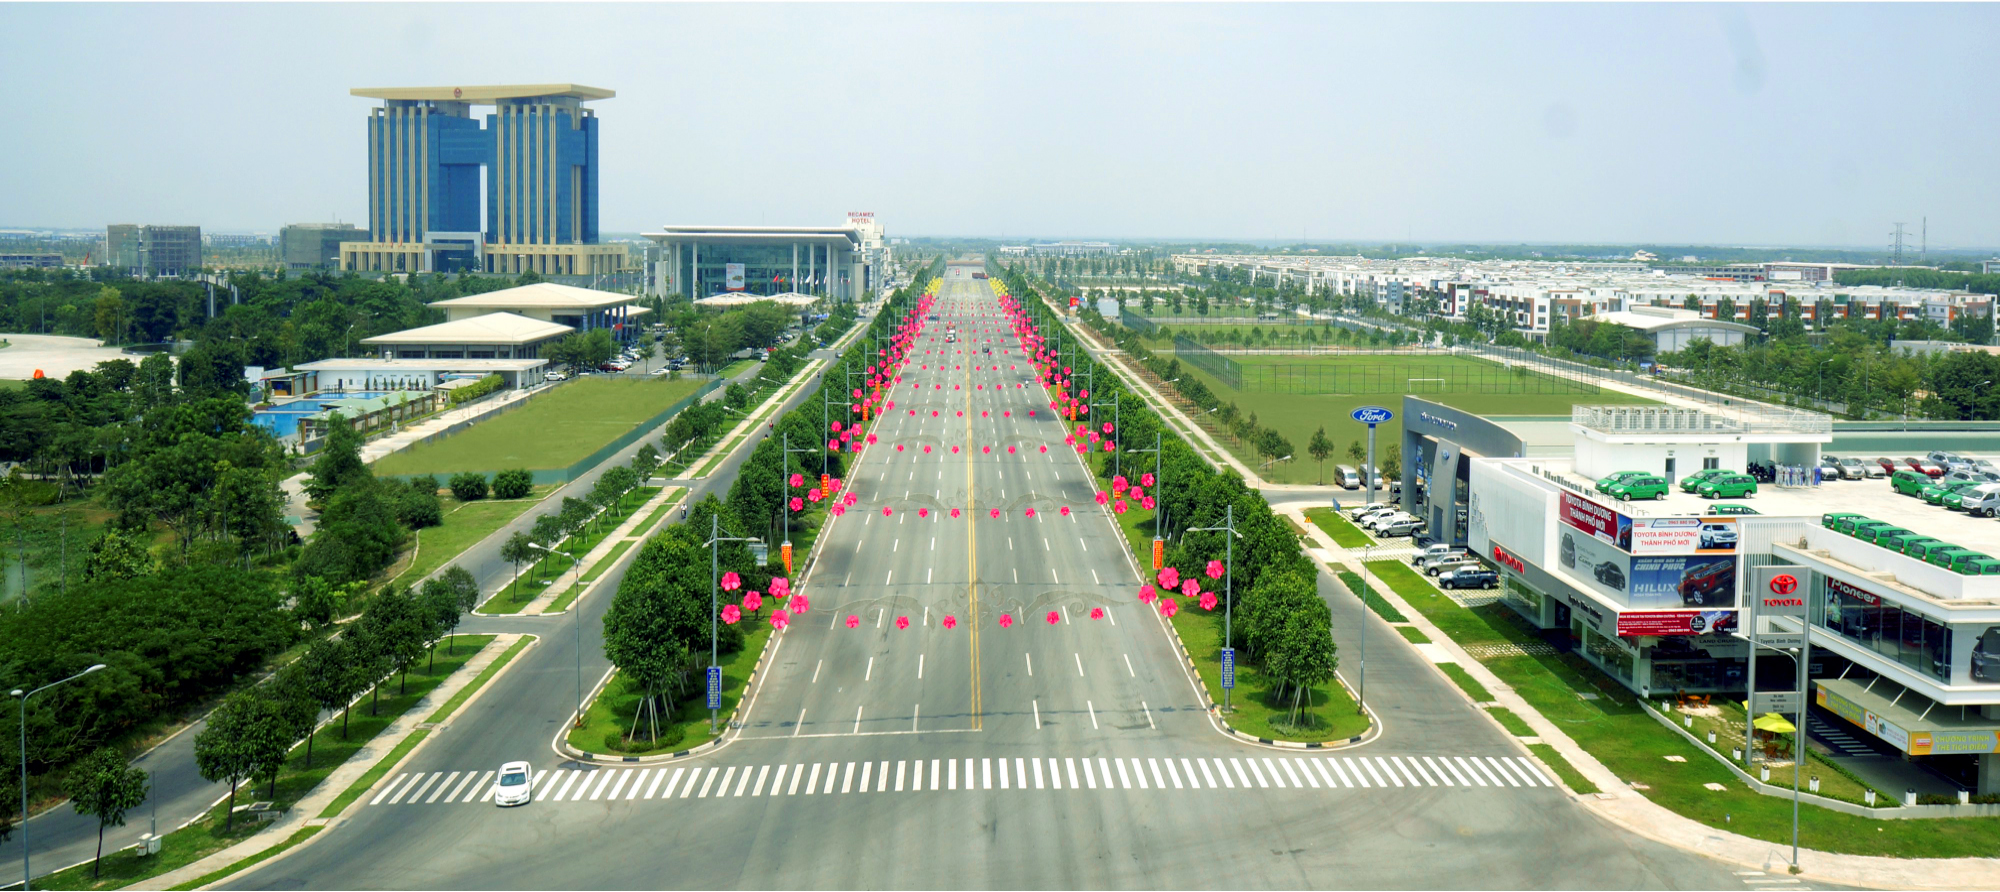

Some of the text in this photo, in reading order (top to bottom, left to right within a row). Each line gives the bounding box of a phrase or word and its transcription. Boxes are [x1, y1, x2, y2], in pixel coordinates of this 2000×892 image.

[1360, 409, 1386, 421] Ford
[1634, 584, 1676, 592] HILUX
[1831, 578, 1876, 604] Pioneer
[1763, 598, 1803, 607] TOYOTA
